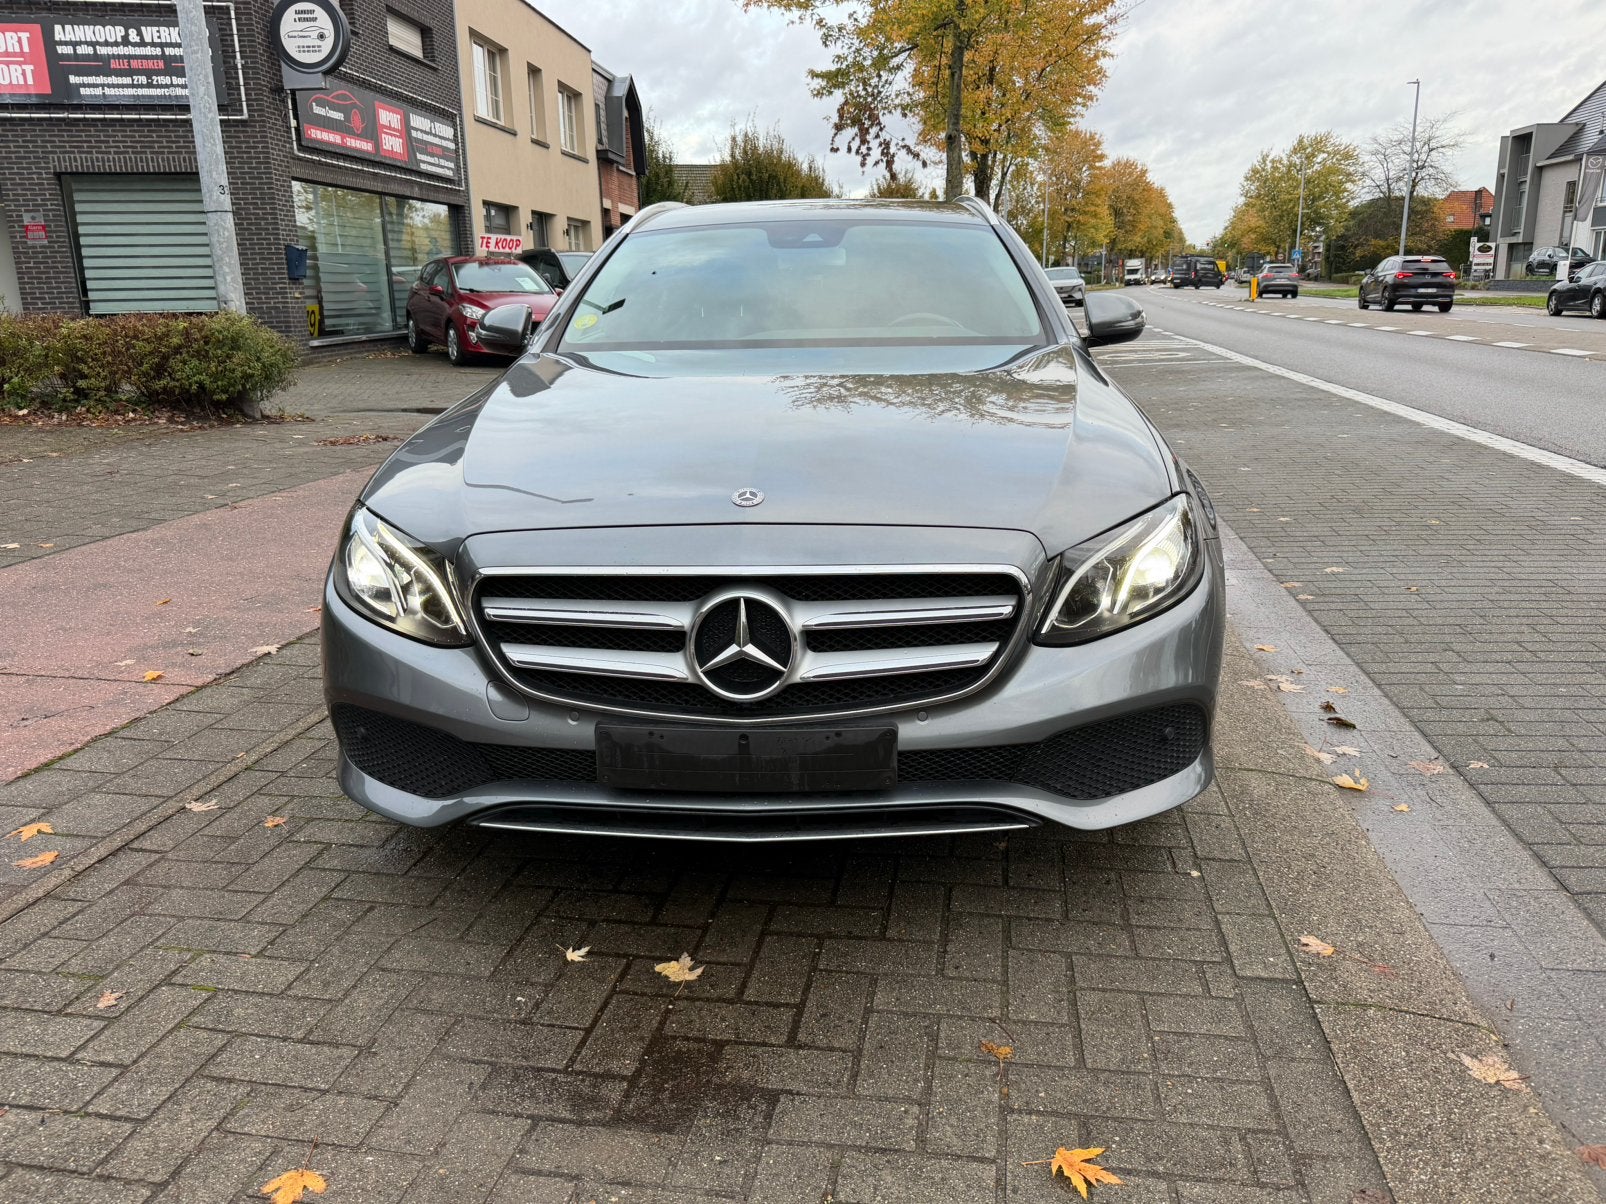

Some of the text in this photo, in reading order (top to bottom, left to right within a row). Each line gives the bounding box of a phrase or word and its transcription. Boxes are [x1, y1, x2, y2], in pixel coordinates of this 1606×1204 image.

[54, 24, 209, 43] AANKOOP & VERK
[56, 45, 74, 54] van
[76, 44, 94, 54] alle
[96, 45, 162, 55] tweedehandse
[110, 59, 164, 70] ALLE MERKEN
[68, 74, 132, 84] Herentalsebaan
[132, 76, 147, 84] 279
[152, 76, 172, 85] 2150
[378, 108, 401, 130] IMPORT
[382, 134, 403, 154] EXPORT
[480, 236, 521, 250] TE KOOP
